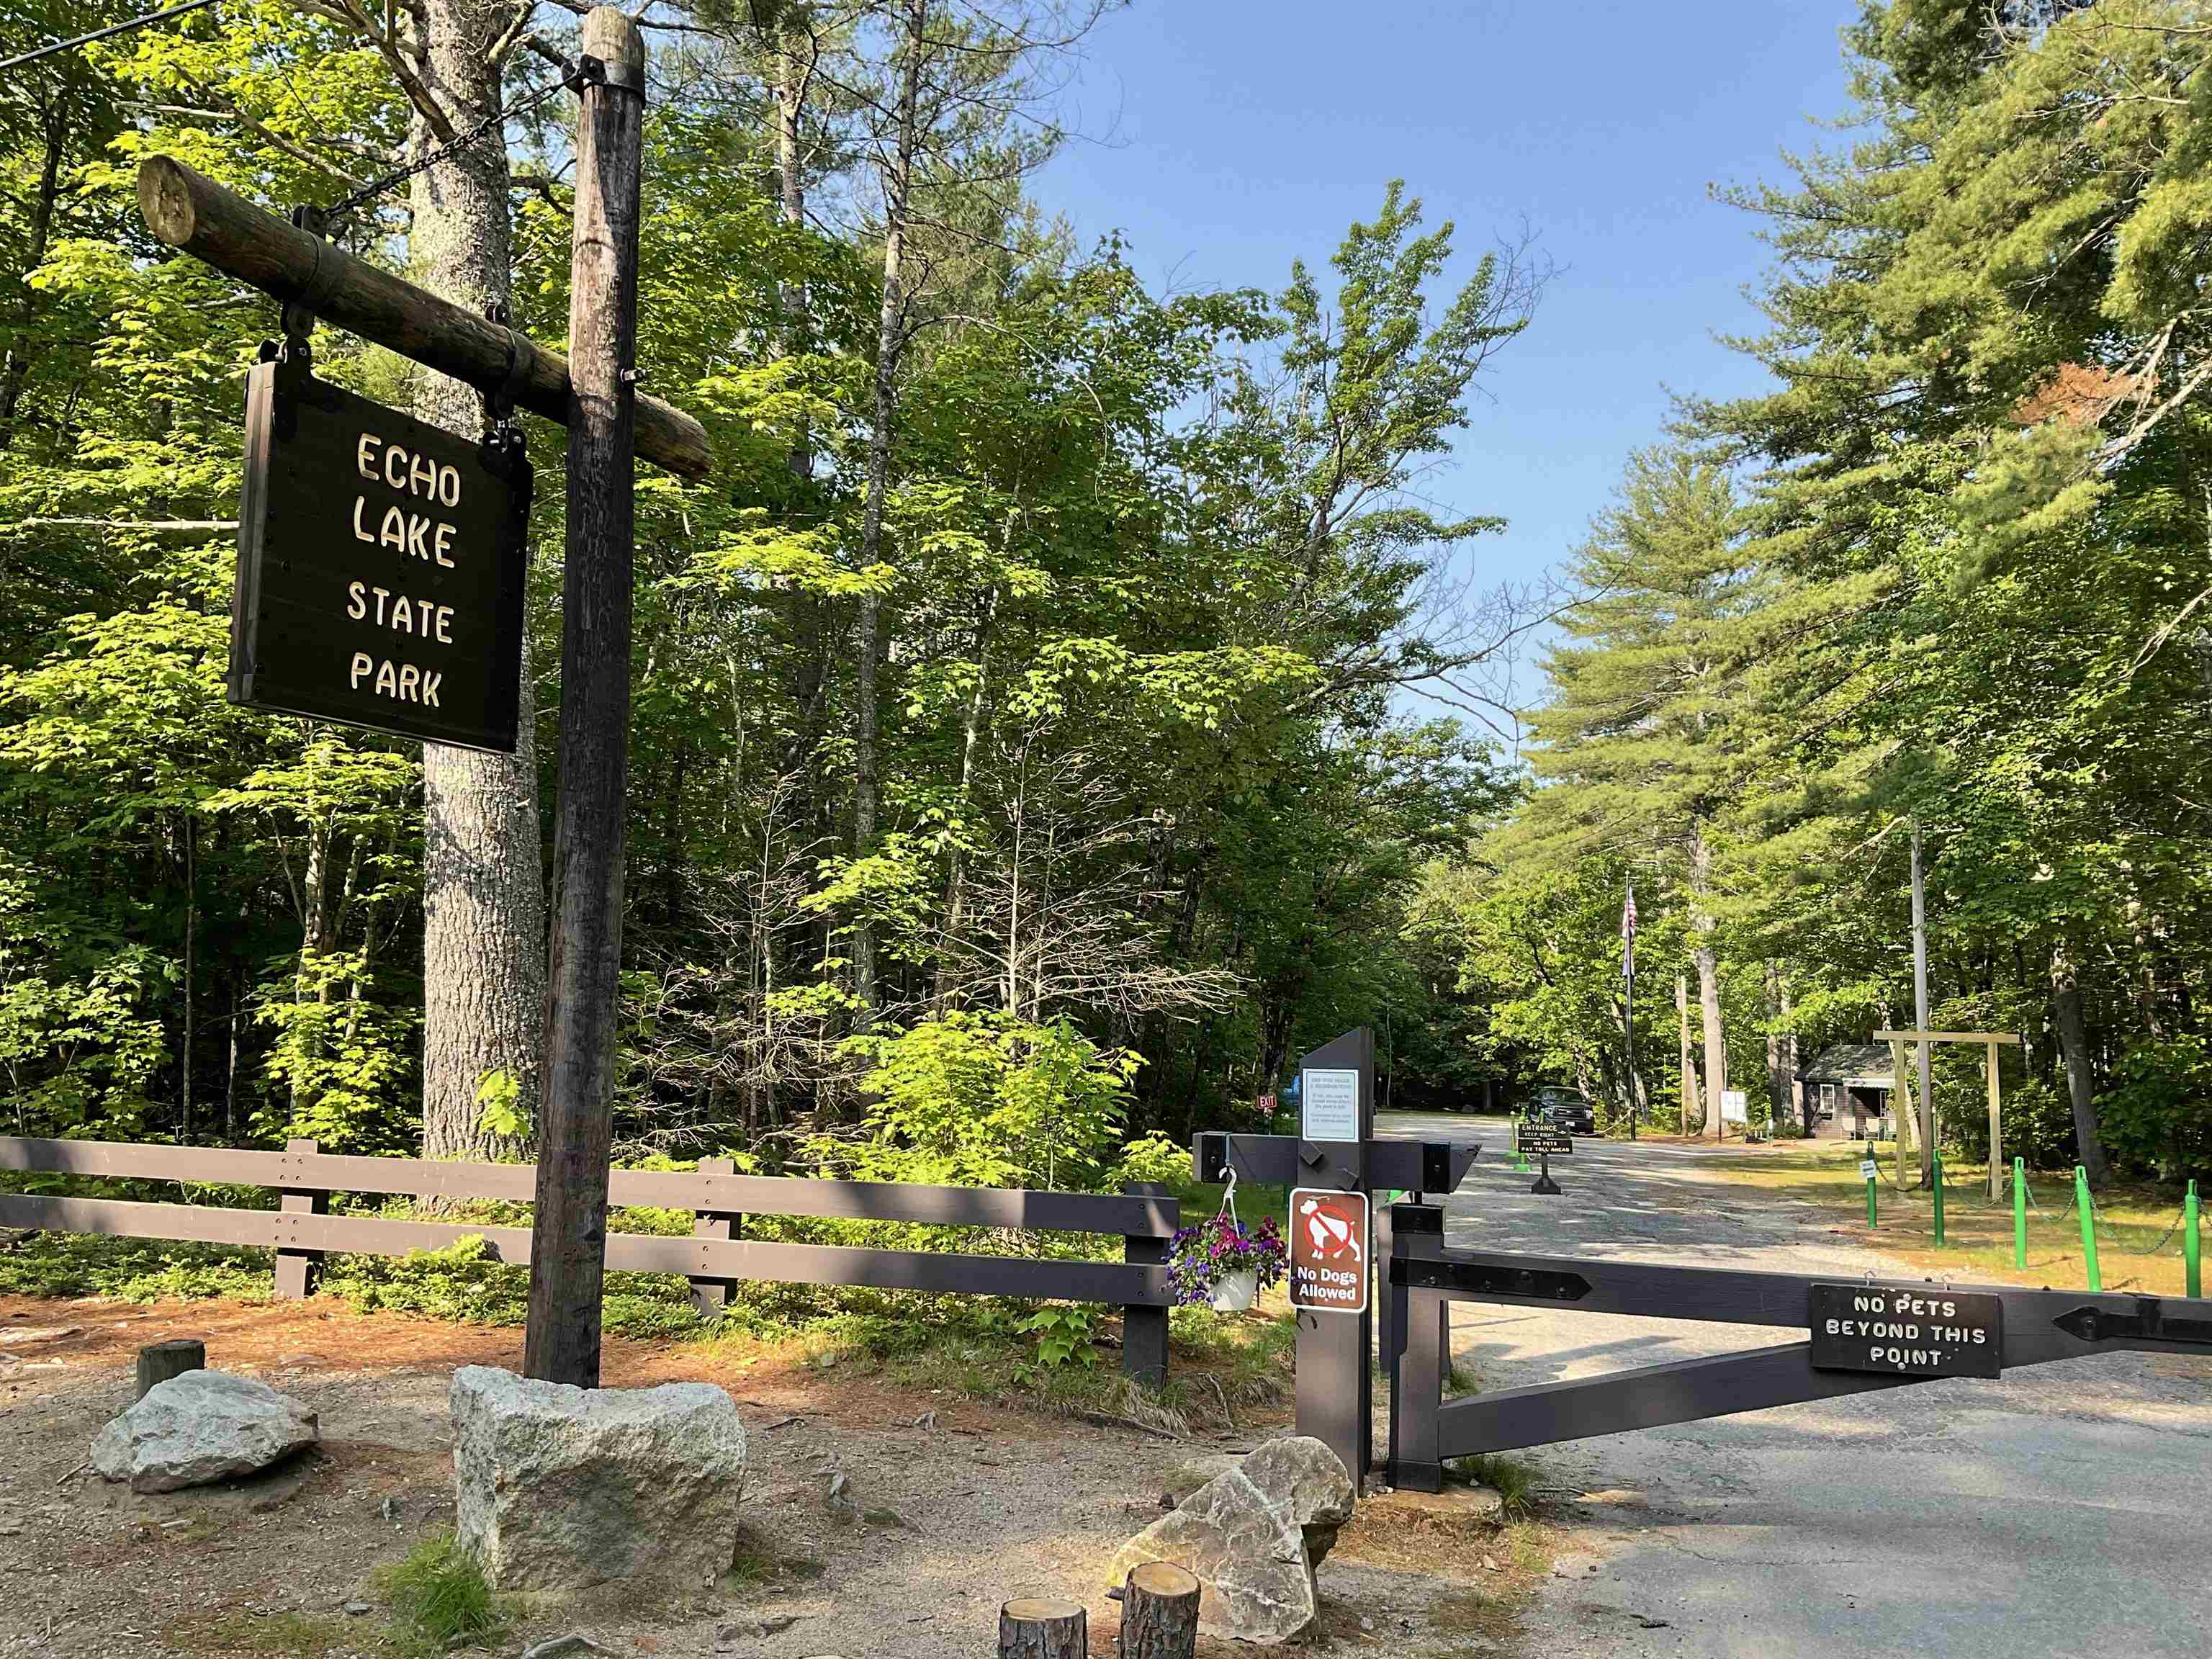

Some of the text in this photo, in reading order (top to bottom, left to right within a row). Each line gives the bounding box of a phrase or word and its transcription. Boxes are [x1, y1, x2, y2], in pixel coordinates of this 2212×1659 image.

[357, 433, 460, 507] ECHO
[354, 496, 457, 568] LAKE
[347, 582, 454, 644] STATE
[351, 652, 441, 708] PARK
[1260, 1095, 1274, 1107] EXIT
[1298, 1267, 1357, 1285] No Dogs
[1299, 1284, 1356, 1300] Allowed
[1854, 1296, 1956, 1318] NO PETS
[1826, 1318, 1986, 1344] BEYOND THIS
[1870, 1346, 1941, 1366] POINT
